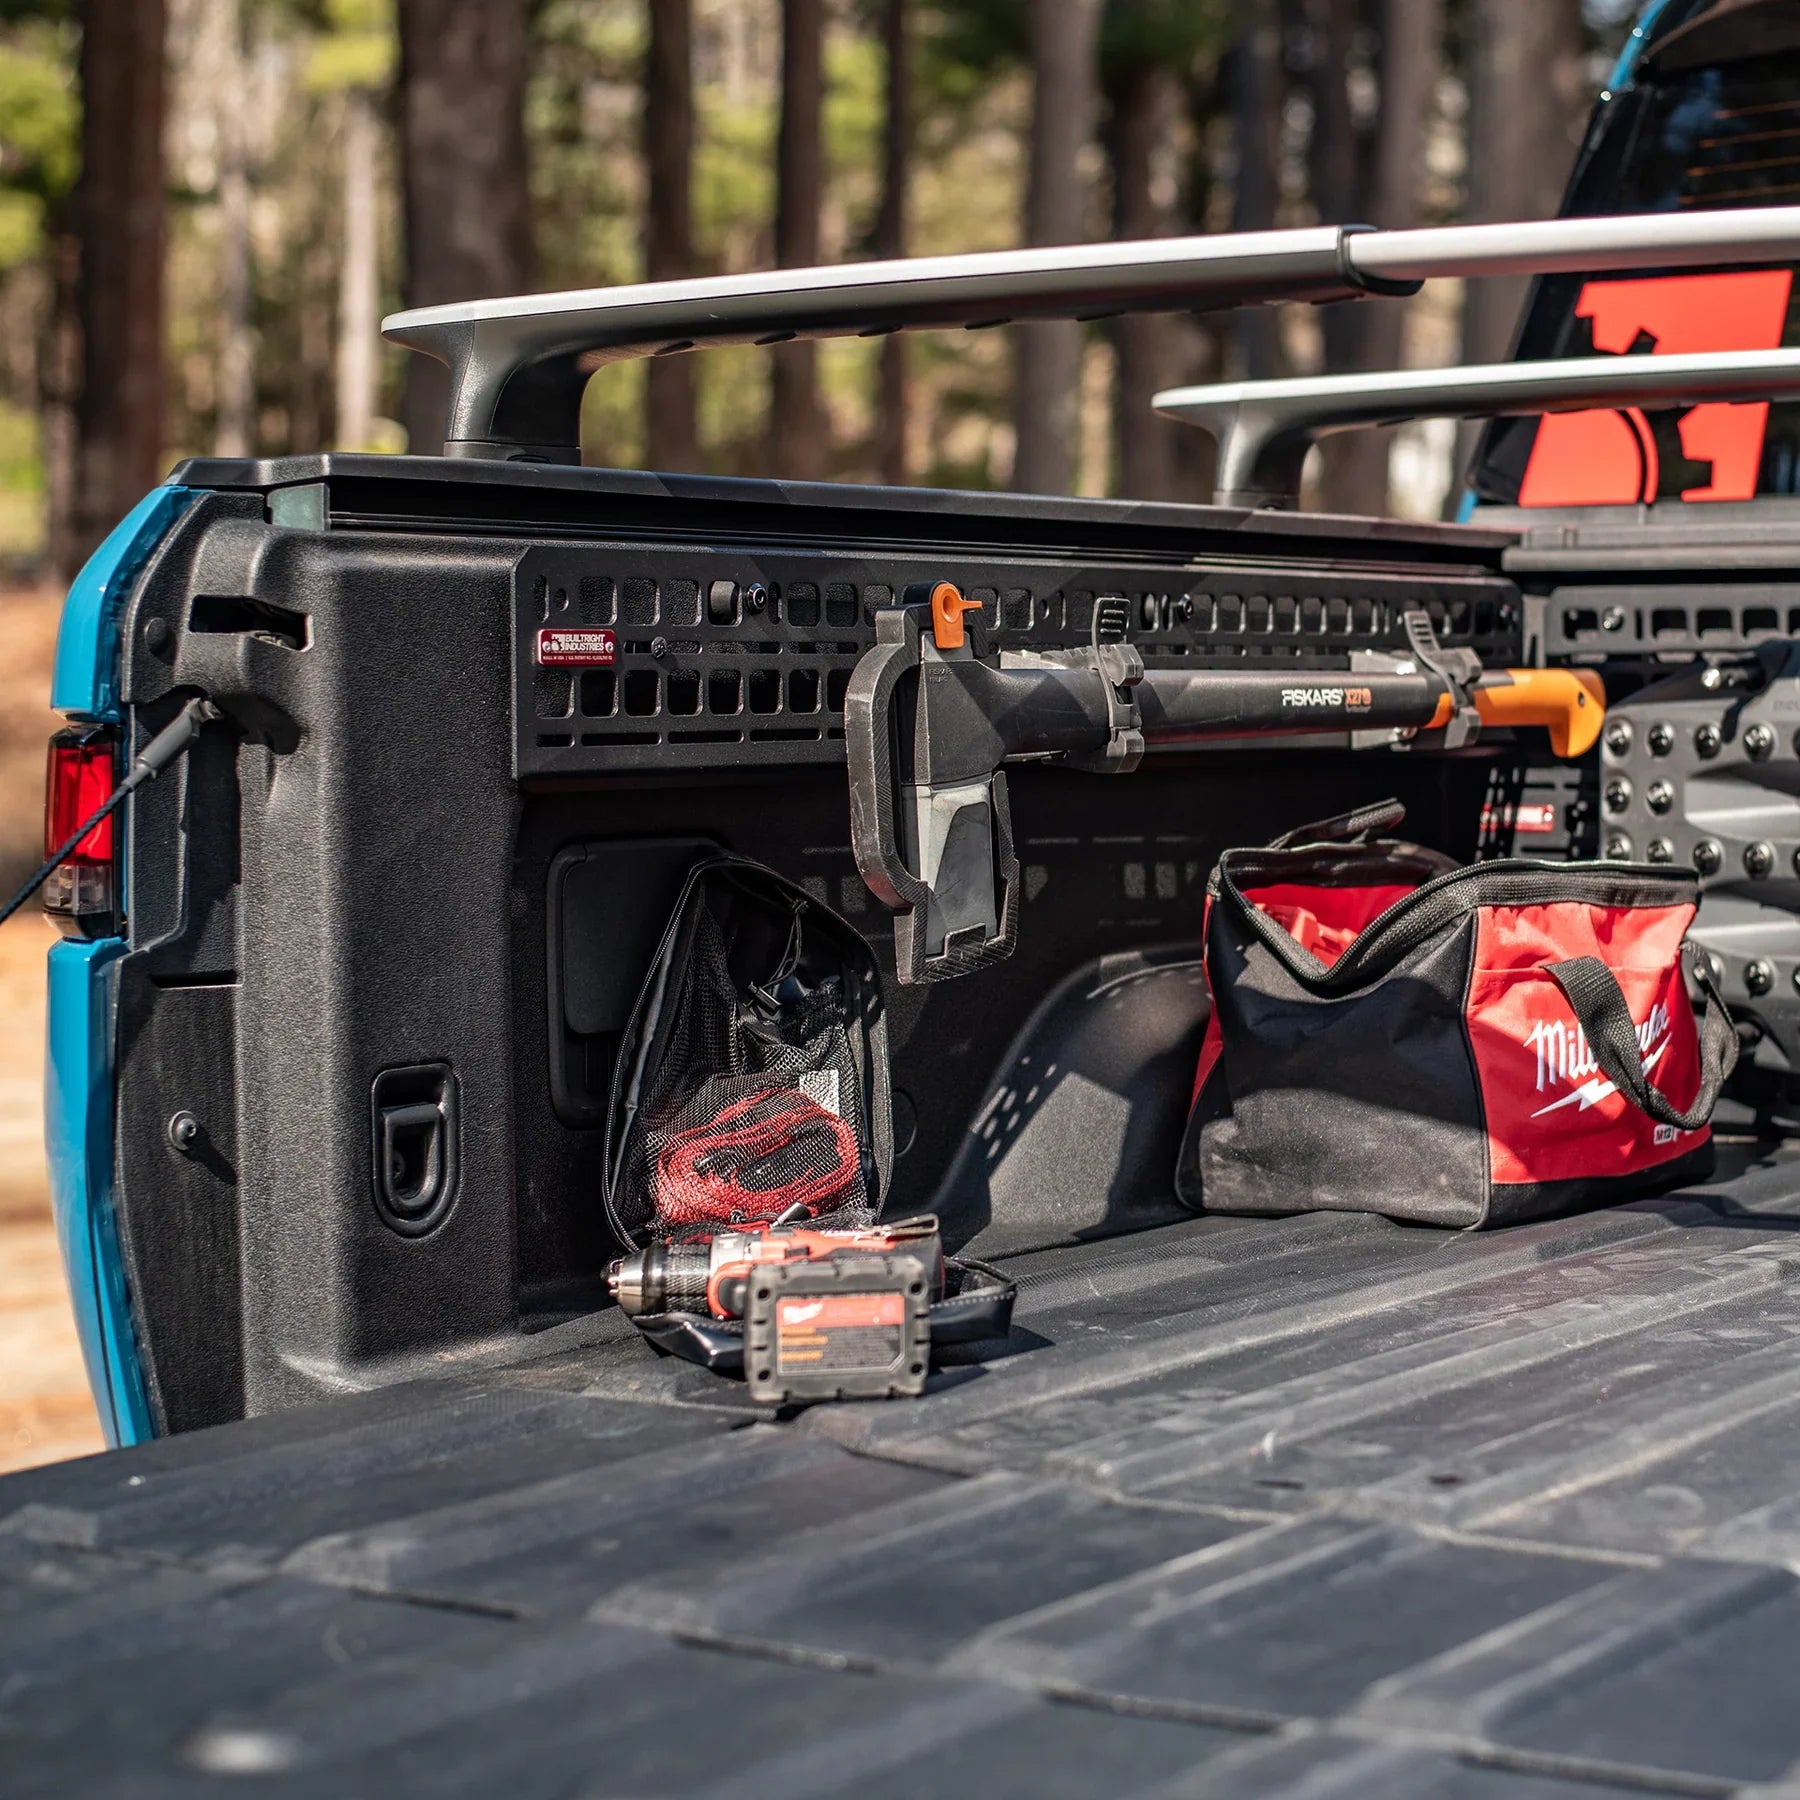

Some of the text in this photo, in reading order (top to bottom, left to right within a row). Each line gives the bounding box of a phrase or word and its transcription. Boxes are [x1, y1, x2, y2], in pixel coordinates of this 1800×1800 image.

[565, 633, 605, 643] BUILTRIGHT
[565, 642, 605, 651] INDUSTRIES
[1281, 687, 1343, 706] FISKARS
